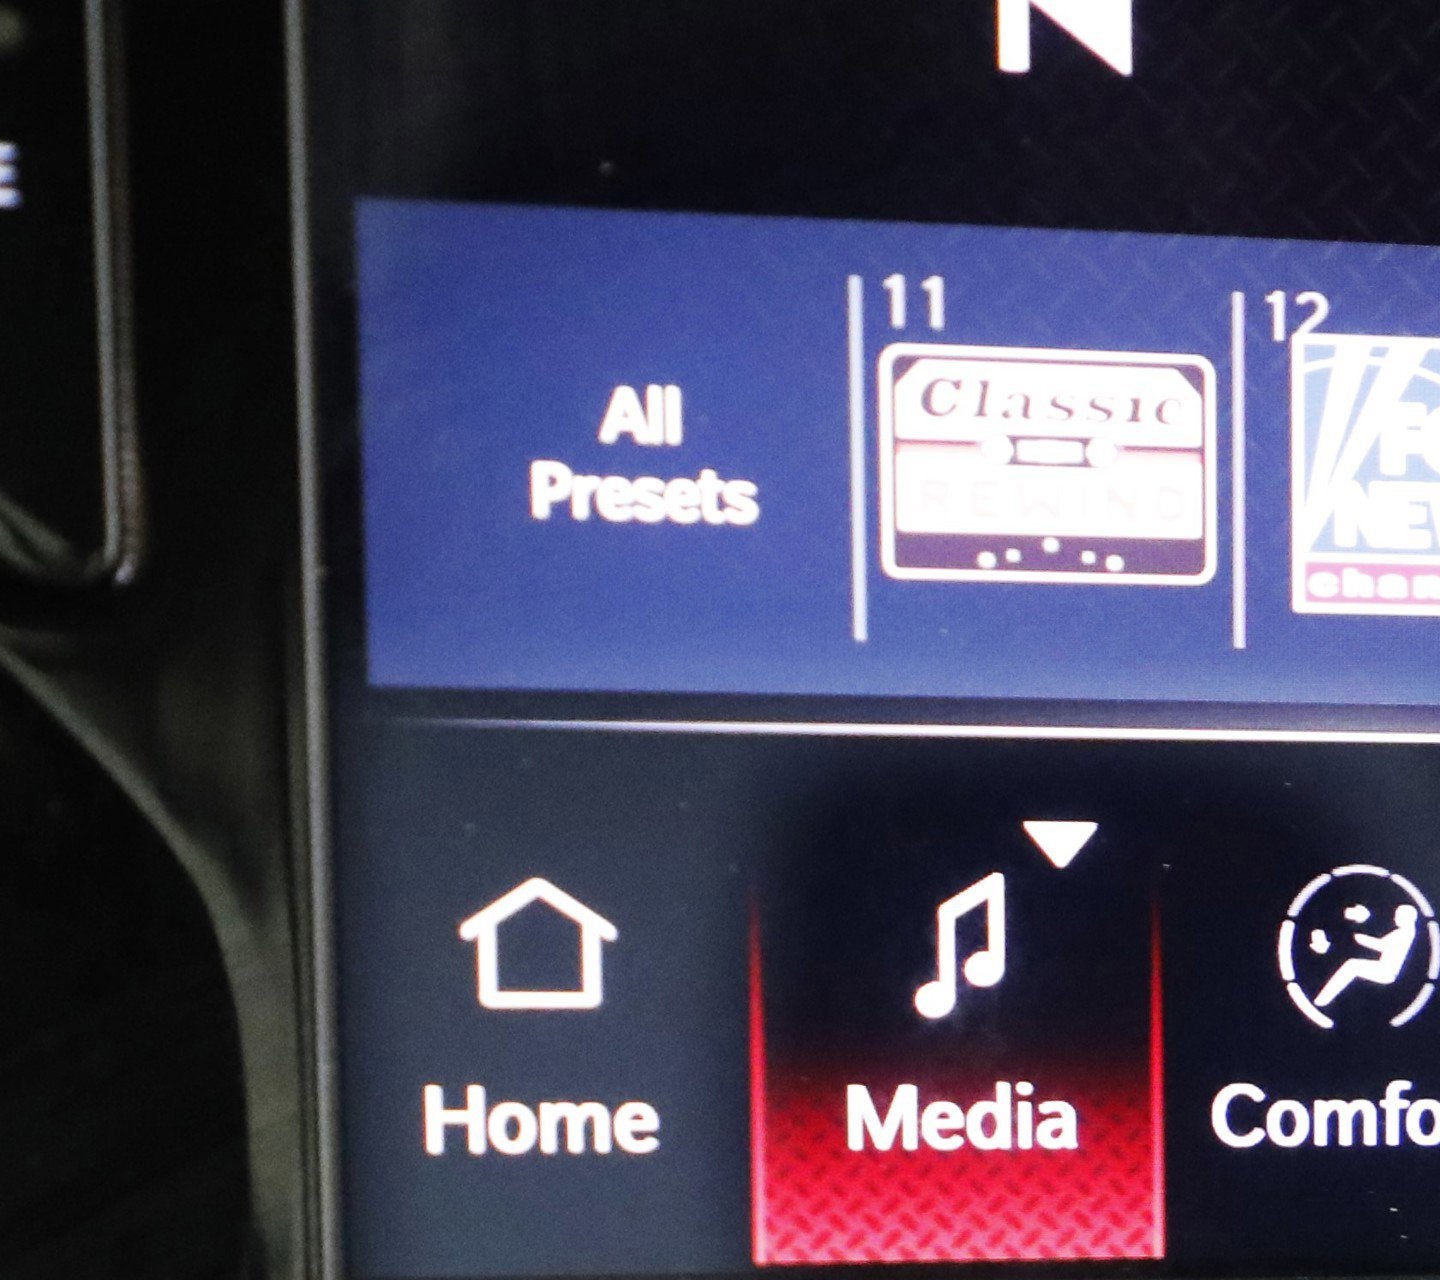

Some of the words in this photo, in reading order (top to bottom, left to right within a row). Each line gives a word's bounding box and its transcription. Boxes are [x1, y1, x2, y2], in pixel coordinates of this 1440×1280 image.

[883, 273, 947, 331] 11
[1264, 289, 1331, 343] 12
[598, 384, 684, 447] All
[919, 376, 1184, 426] Classic
[529, 459, 761, 527] Presets
[422, 1084, 662, 1155] Home
[845, 1079, 1080, 1153] Media
